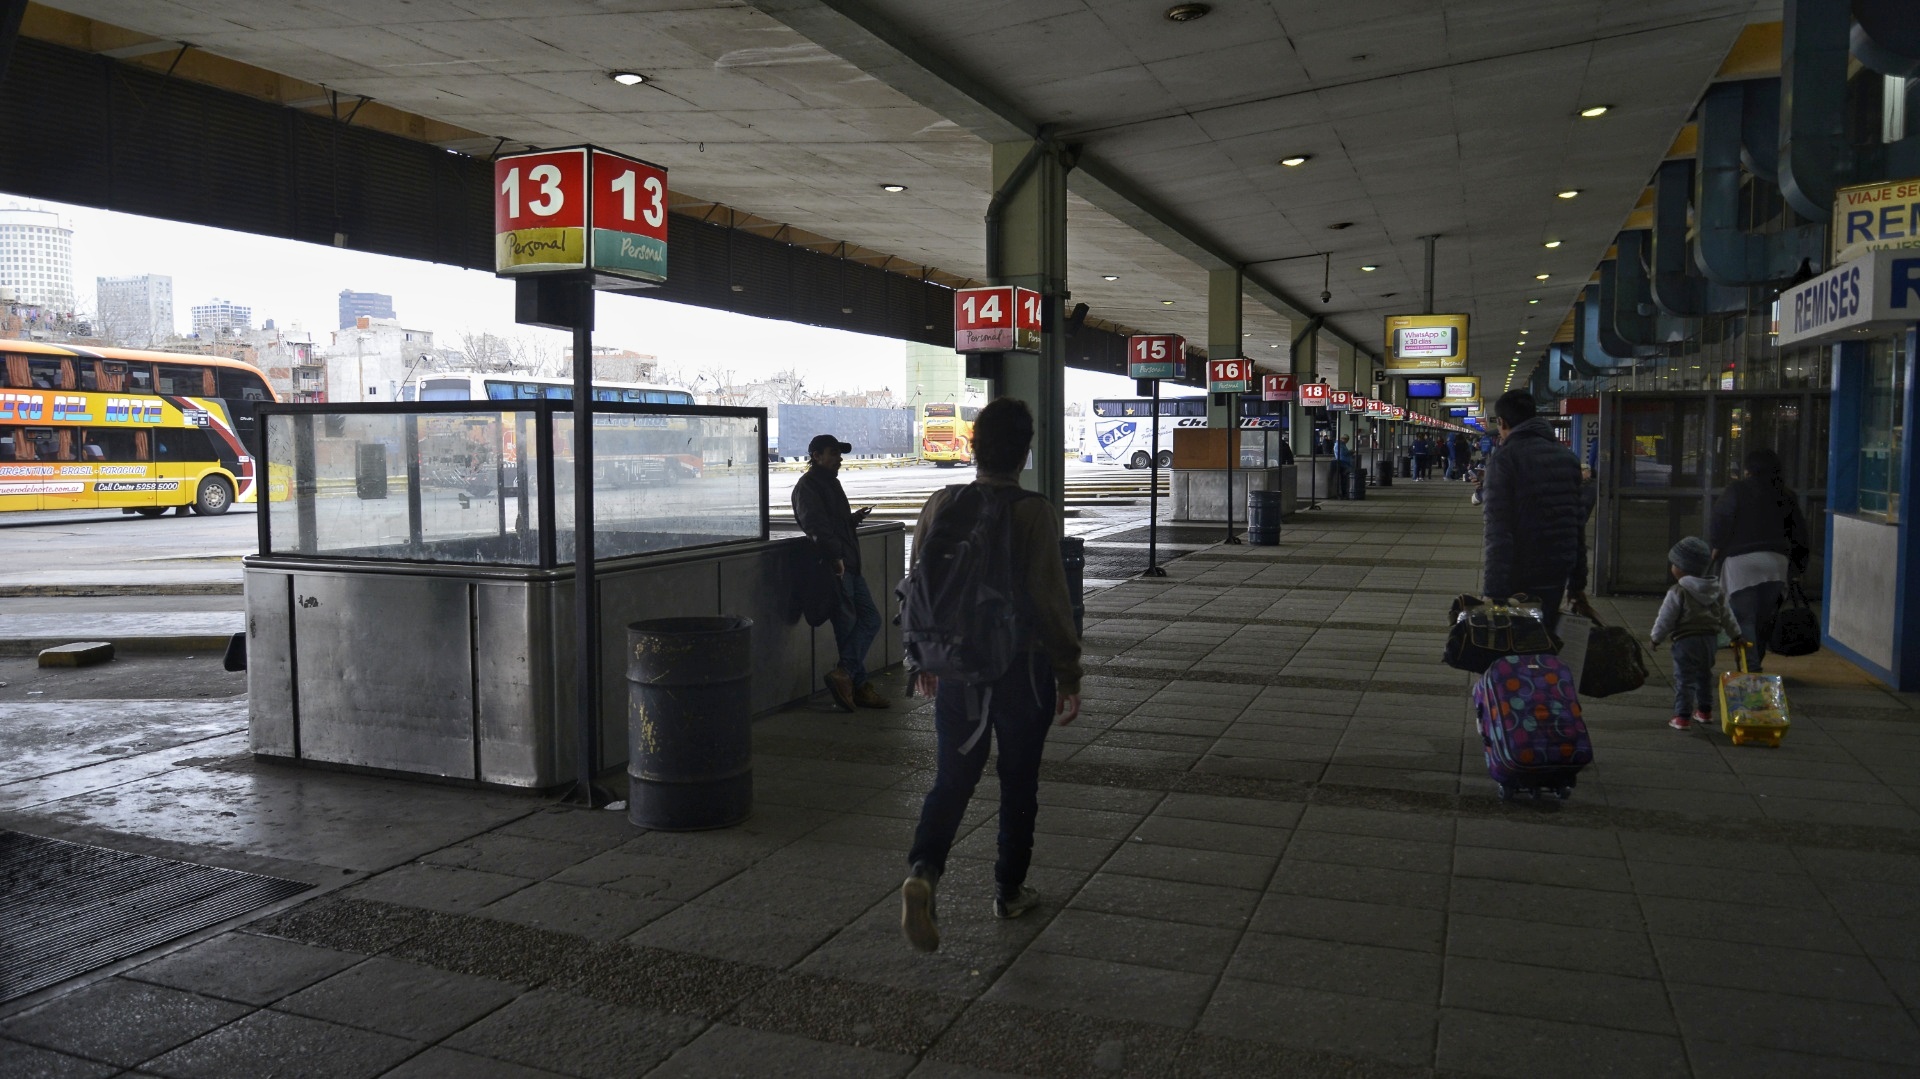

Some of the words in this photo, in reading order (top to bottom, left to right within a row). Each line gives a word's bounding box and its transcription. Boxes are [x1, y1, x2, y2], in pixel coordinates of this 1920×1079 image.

[502, 164, 564, 219] 13
[611, 169, 664, 228] 13
[1847, 188, 1891, 205] VIAJE
[1896, 184, 1920, 199] SE
[505, 230, 566, 257] Personal
[620, 237, 663, 262] Personal
[1795, 267, 1860, 334] REMISES
[962, 294, 1003, 324] 14
[966, 329, 1004, 345] Personal
[1405, 331, 1439, 339] WhatsApp
[1136, 340, 1166, 360] 15
[1140, 363, 1165, 374] Personal
[1214, 363, 1239, 379] 16
[1375, 370, 1386, 382] B
[1269, 377, 1288, 390] 17
[1305, 386, 1323, 397] 18
[1331, 393, 1346, 403] 19
[1352, 398, 1363, 407] 20
[1368, 402, 1378, 410] 21
[0, 393, 44, 420] ERO
[52, 395, 93, 421] DEL
[105, 397, 163, 423] NORTE
[1102, 423, 1131, 445] QAC
[0, 466, 54, 476] ARGENTINA
[61, 466, 93, 475] BRASIL
[100, 466, 147, 476] PARAGUAY
[98, 483, 112, 491] Call
[113, 483, 135, 491] Center
[135, 482, 156, 490] 5258
[158, 482, 178, 490] 5000
